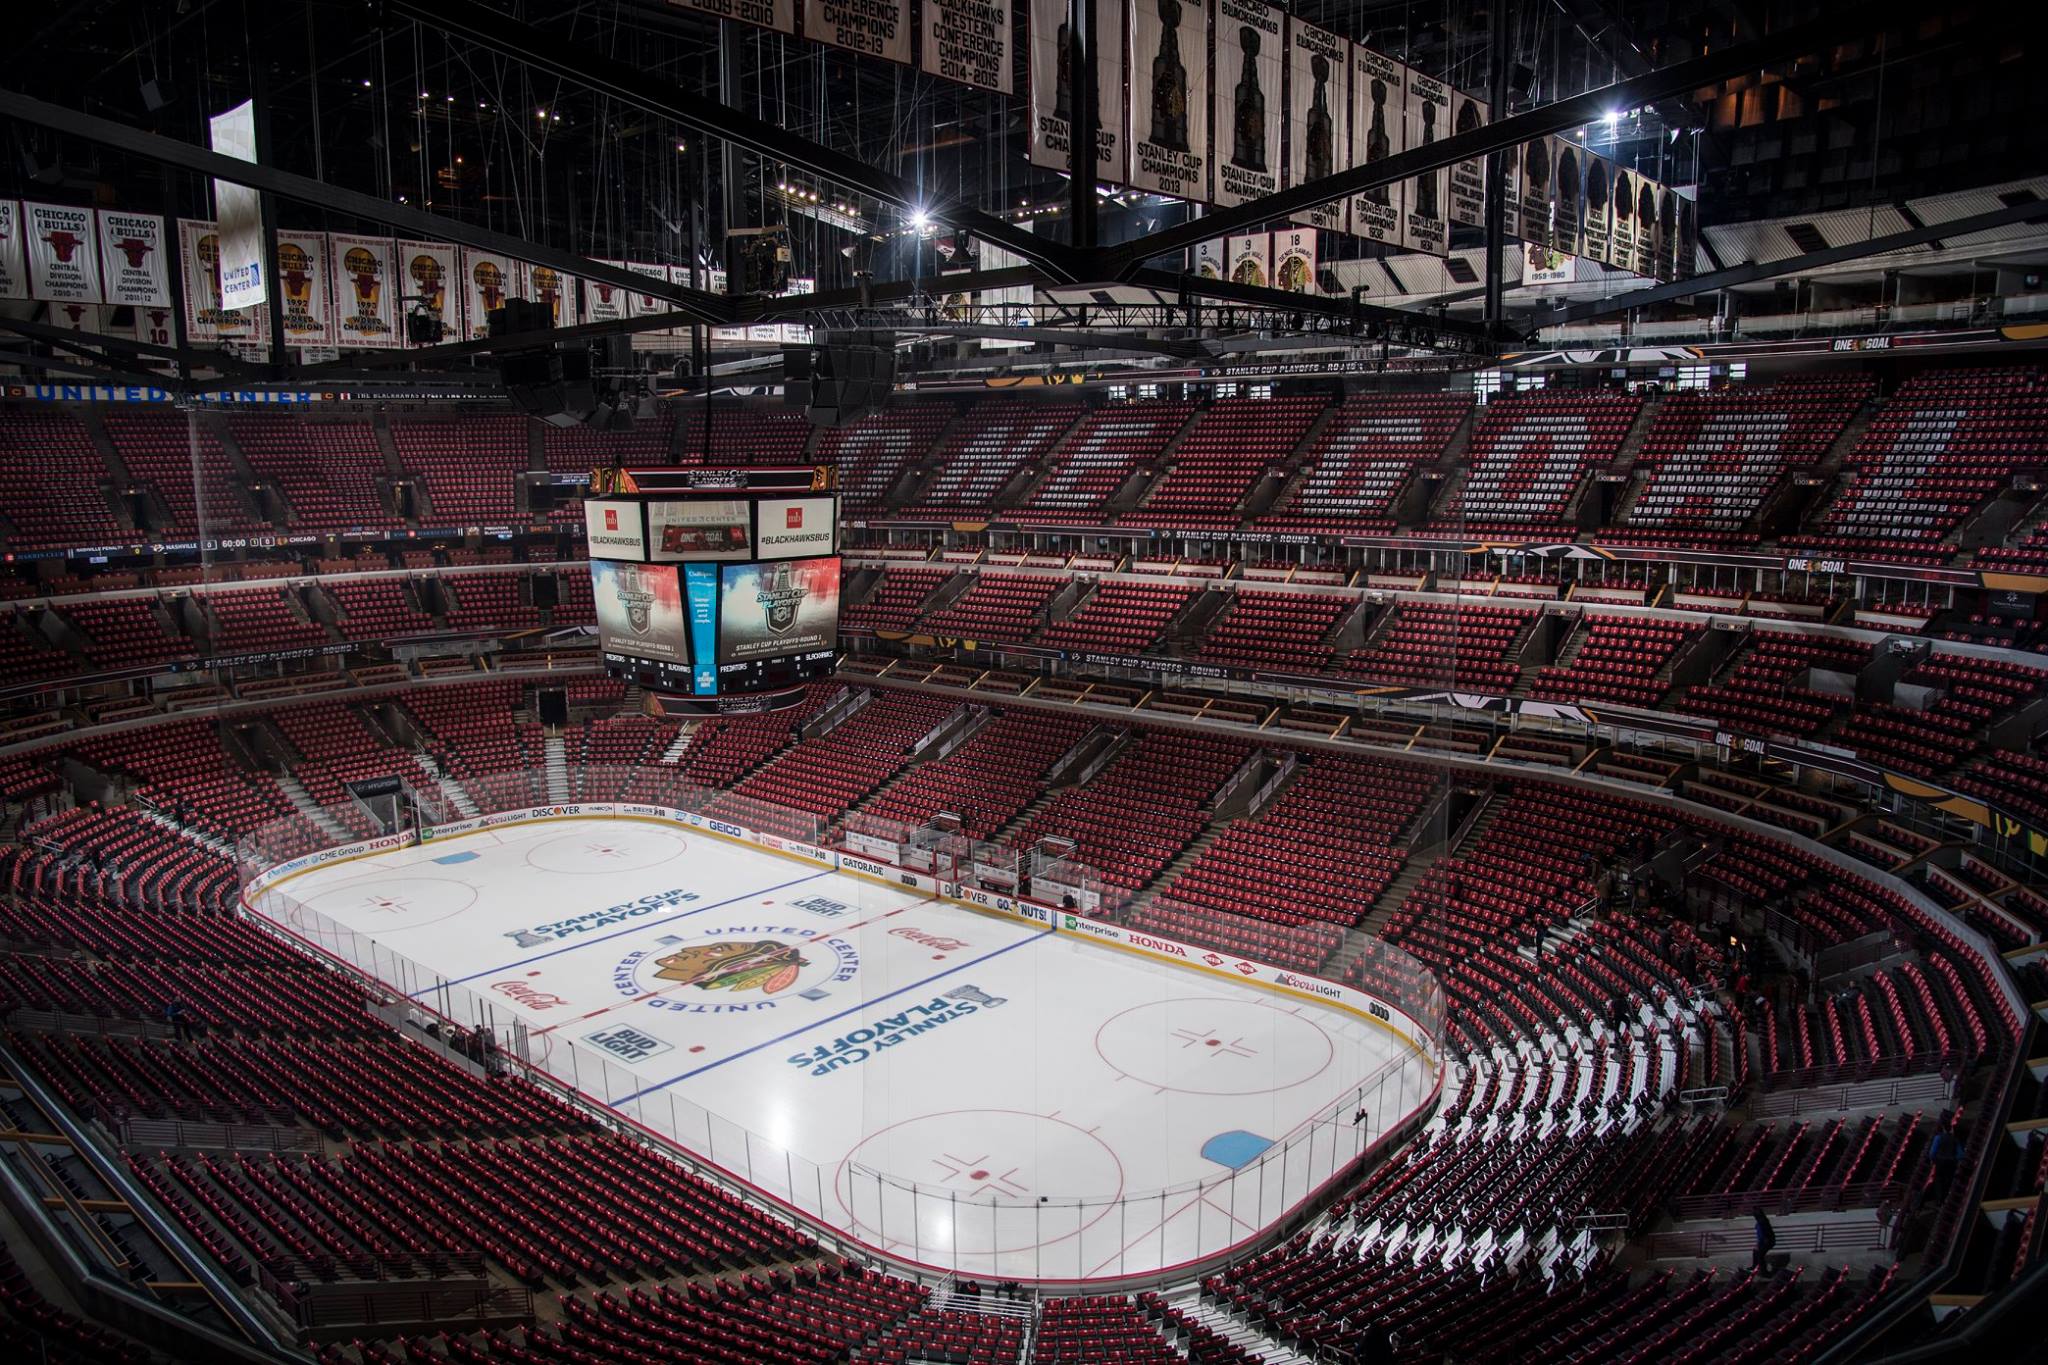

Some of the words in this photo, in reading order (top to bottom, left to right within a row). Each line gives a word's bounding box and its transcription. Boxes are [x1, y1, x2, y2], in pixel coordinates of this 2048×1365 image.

[823, 7, 894, 39] CHAMPIONS
[941, 8, 995, 36] WESTERN
[836, 27, 883, 53] 2012-13
[933, 23, 1003, 57] CONFERENCE
[1304, 24, 1336, 48] CHICAGO
[938, 40, 999, 71] CHAMPIONS
[1365, 51, 1394, 73] CHICAGO
[939, 59, 998, 88] 2014-2015
[1137, 141, 1179, 164] STANLEY
[1182, 154, 1202, 172] CUP
[1142, 158, 1198, 184] CHAMPIONS
[1221, 165, 1257, 187] STANLEY
[1159, 176, 1180, 194] 2013
[35, 208, 87, 223] CHICAGO
[1356, 199, 1382, 217] STANLEY
[1385, 207, 1398, 221] CUP
[44, 220, 82, 233] BULLS
[108, 216, 157, 230] CHICAGO
[1311, 212, 1327, 227] 1961
[1359, 211, 1395, 231] CHAMPIONS
[116, 228, 152, 240] BULLS
[1290, 234, 1301, 246] 18
[1201, 245, 1208, 255] 3
[1245, 239, 1252, 250] 9
[1278, 249, 1294, 263] DENIS
[50, 263, 81, 272] CENTRAL
[122, 269, 151, 278] CENTRAL
[224, 266, 250, 281] UNITED
[49, 271, 82, 281] DIVISION
[122, 277, 153, 286] DIVISION
[45, 280, 88, 290] CHAMPIONS
[117, 285, 159, 295] CHAMPIONS
[224, 280, 251, 294] CENTER
[197, 317, 252, 328] CHAMPIONS
[343, 323, 391, 335] CHAMPIONS
[150, 329, 169, 345] 10
[1833, 340, 1852, 351] ONE
[1866, 336, 1890, 349] GOAL
[1225, 364, 1259, 376] STANLEY
[1261, 363, 1278, 374] CUP
[1279, 362, 1320, 374] PLAYOFFS
[35, 385, 165, 401] UNITED
[200, 391, 313, 403] CENTER
[688, 470, 729, 478] STANLEY
[730, 470, 750, 478] CUP
[688, 477, 735, 485] PLAYOFFS
[665, 516, 697, 524] UNITED
[706, 515, 737, 523] CENTER
[222, 539, 246, 549] 60:00
[289, 536, 317, 544] CHICAGO
[590, 535, 641, 547] #BLACKHAWKSBUS
[761, 533, 830, 545] #BLACKHAWKSBUS
[1176, 531, 1209, 540] STANLEY
[1211, 531, 1228, 541] CUP
[1230, 532, 1271, 543] PLAYOFFS
[1280, 534, 1310, 544] ROUND
[1311, 536, 1317, 544] 1
[165, 543, 198, 553] NASHVILLE
[1788, 559, 1808, 571] ONE
[1820, 560, 1845, 573] GOAL
[756, 591, 791, 603] STANLEY
[791, 588, 809, 599] CUP
[762, 598, 801, 609] PLAYOFFS
[736, 643, 760, 651] STANLEY
[760, 641, 772, 649] CUP
[204, 657, 246, 669] STANLEY
[248, 654, 267, 664] CUP
[269, 648, 314, 661] PLAYOFFS
[323, 644, 351, 655] ROUND
[805, 651, 834, 661] BLACKHAWKS
[720, 662, 748, 673] PREDATORS
[1085, 653, 1120, 665] STANLEY
[1122, 657, 1139, 668] CUP
[1140, 659, 1182, 673] PLAYOFFS
[1190, 665, 1221, 677] ROUND
[1222, 668, 1228, 678] 1
[1715, 732, 1734, 746] ONE
[1743, 739, 1766, 755] GOAL
[508, 812, 527, 822] LIGHT
[532, 805, 580, 818] DISCOVER
[709, 820, 742, 837] GEICO
[369, 831, 415, 850] HONDA
[319, 851, 338, 861] CME
[338, 845, 365, 858] Group
[843, 857, 884, 876] GATORADE
[536, 904, 633, 935] STANLEY
[637, 888, 686, 908] CUP
[792, 900, 844, 918] LIGHT
[811, 897, 848, 912] BUD
[553, 892, 701, 938] PLAYOFFS
[704, 925, 817, 937] UNITED
[1068, 917, 1119, 939] enterprise
[887, 927, 974, 951] Coca-Cola
[1128, 934, 1188, 957] HONDA
[827, 937, 860, 983] CENTER
[613, 949, 648, 998] CENTER
[1286, 974, 1316, 992] Coors
[1315, 986, 1341, 999] LIGHT
[490, 980, 573, 1011] Coca-Cola
[648, 1000, 777, 1014] UNITED
[786, 997, 953, 1069] PLAYOFFS
[875, 1000, 979, 1053] STANLEY
[589, 1031, 650, 1061] LIGHT
[614, 1027, 659, 1050] BUD
[811, 1048, 871, 1076] CUP
